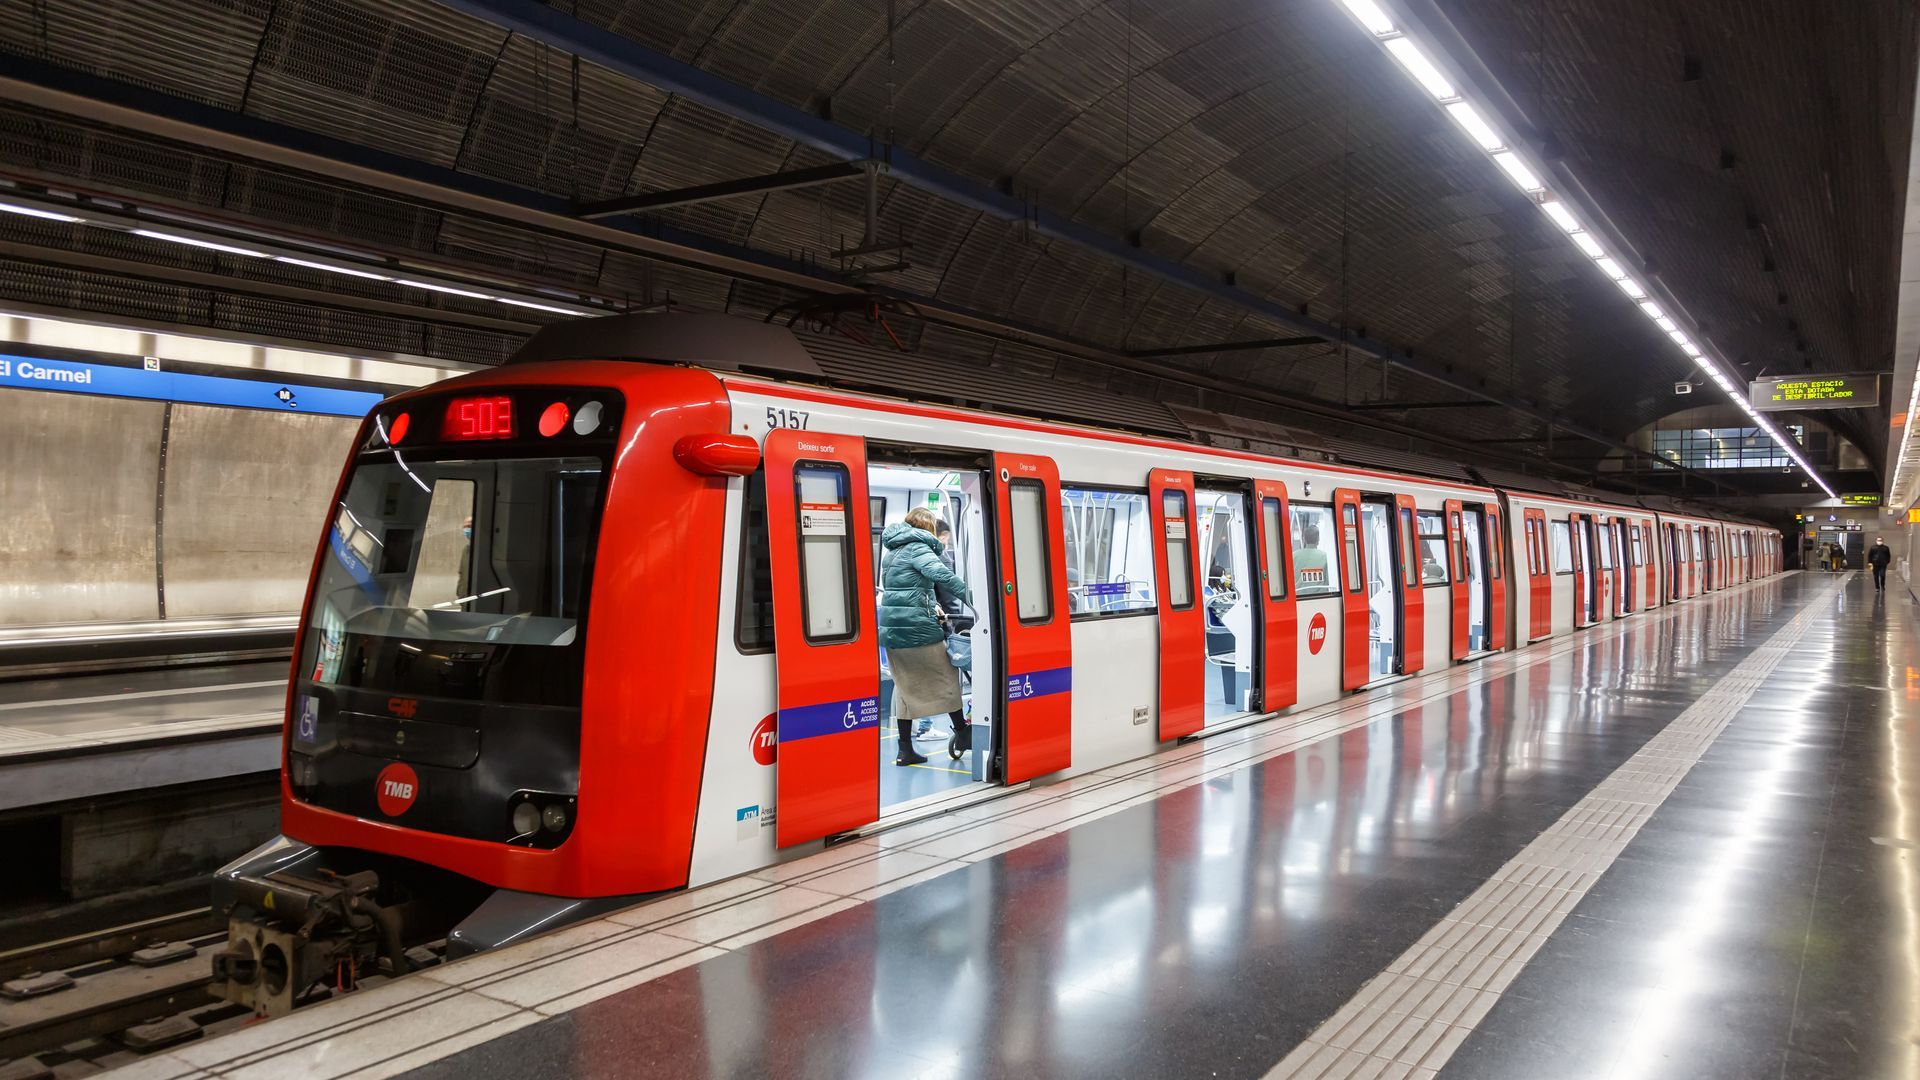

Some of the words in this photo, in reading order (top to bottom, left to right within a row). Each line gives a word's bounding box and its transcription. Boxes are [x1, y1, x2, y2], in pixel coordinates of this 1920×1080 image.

[17, 362, 92, 384] Carmel
[1776, 382, 1808, 390] AQUESTA
[279, 390, 290, 400] M
[461, 400, 511, 435] 503
[766, 406, 810, 430] 5157
[1311, 626, 1325, 641] TMB
[861, 706, 878, 714] ACCESO
[861, 714, 878, 722] ACCESS
[760, 731, 778, 748] TM
[385, 780, 413, 800] TMB
[743, 810, 757, 820] ATM
